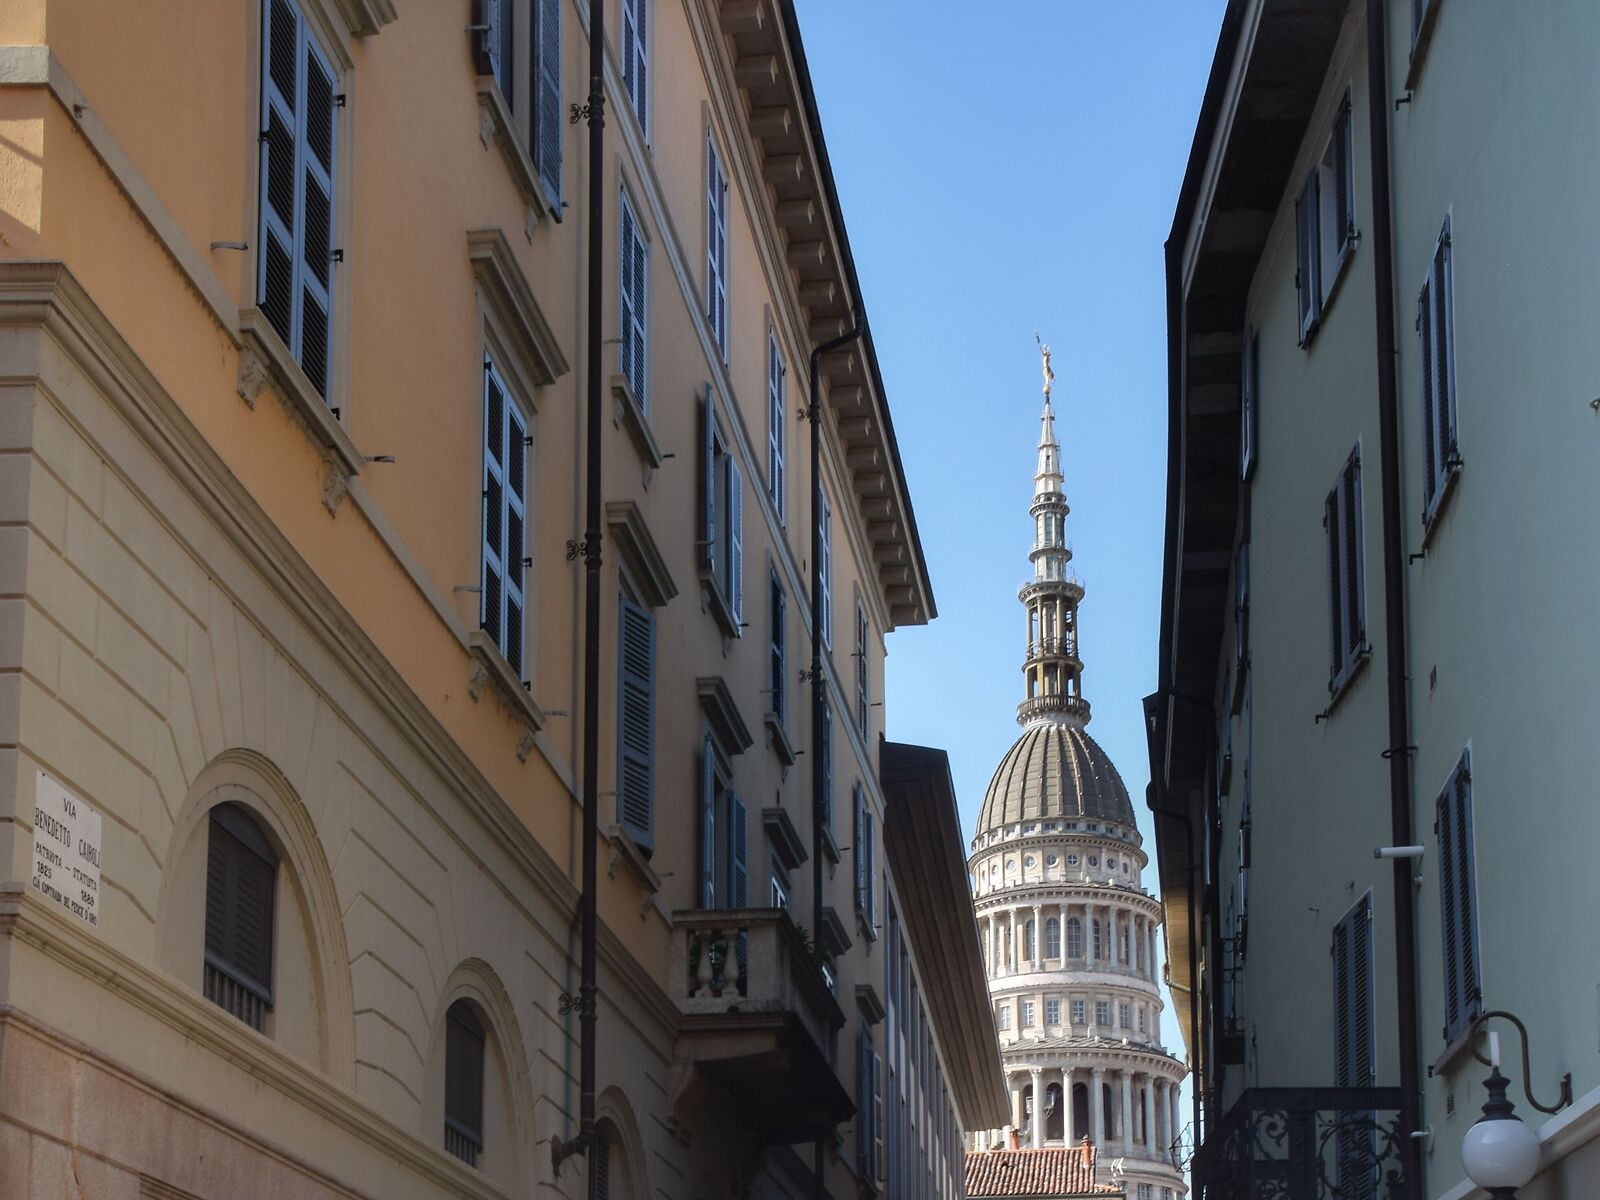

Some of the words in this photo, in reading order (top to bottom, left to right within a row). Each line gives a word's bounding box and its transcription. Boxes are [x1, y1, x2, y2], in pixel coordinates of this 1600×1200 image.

[63, 798, 77, 819] VIA
[35, 808, 71, 848] BENEDETTO
[78, 839, 101, 868] CAIROLI
[35, 842, 62, 869] PATRIOTA
[37, 861, 52, 879] 1825
